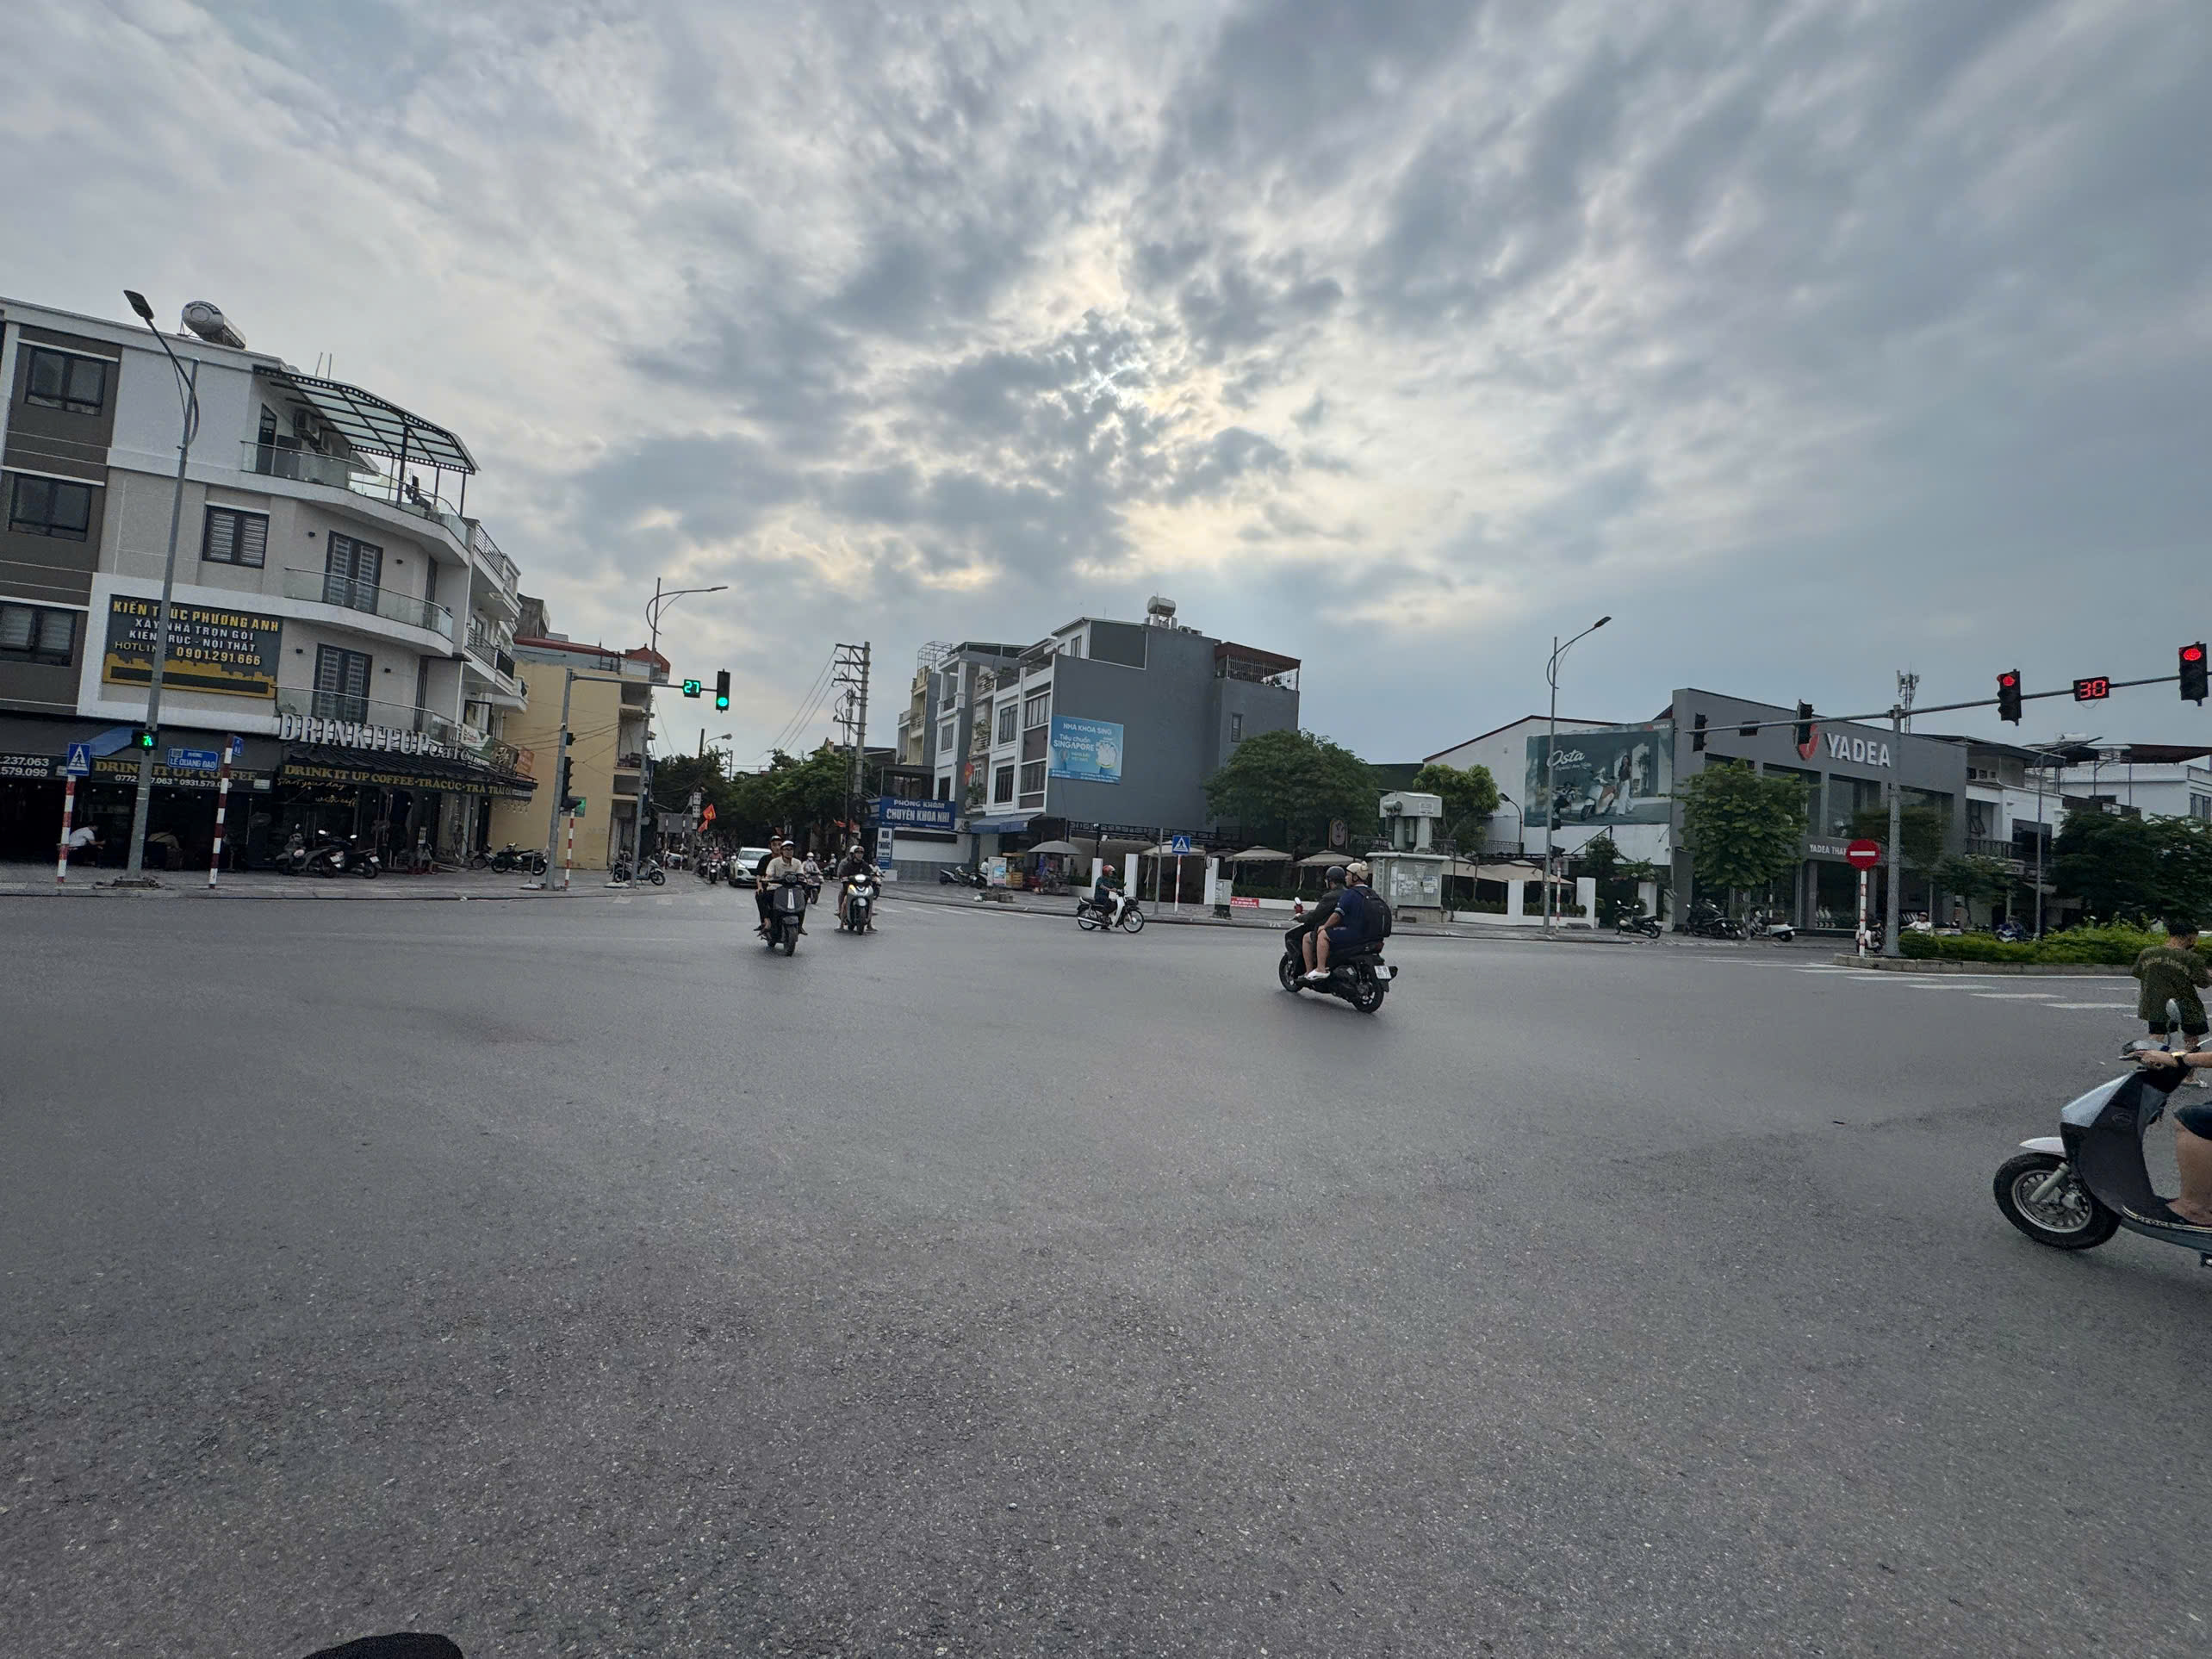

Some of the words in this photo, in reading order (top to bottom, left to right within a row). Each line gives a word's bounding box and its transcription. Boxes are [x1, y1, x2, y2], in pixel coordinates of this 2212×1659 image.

[113, 600, 146, 617] KIẾN
[152, 606, 188, 621] TÚC
[251, 617, 279, 632] ANH
[168, 633, 191, 645] RÚC
[196, 625, 227, 638] TRỌN
[232, 630, 254, 641] GÓI
[177, 646, 261, 666] 0901.291.666
[684, 680, 699, 693] 27
[2080, 680, 2106, 699] 30
[279, 712, 369, 749] DRINK
[1053, 739, 1095, 752] SINGAPORE
[1826, 733, 1891, 767] YADEA
[96, 761, 140, 774] DRIN
[284, 764, 332, 778] DRINK
[334, 769, 349, 780] IT
[351, 771, 370, 781] UP
[916, 810, 936, 822] KHOA
[1809, 844, 1830, 854] YADEA
